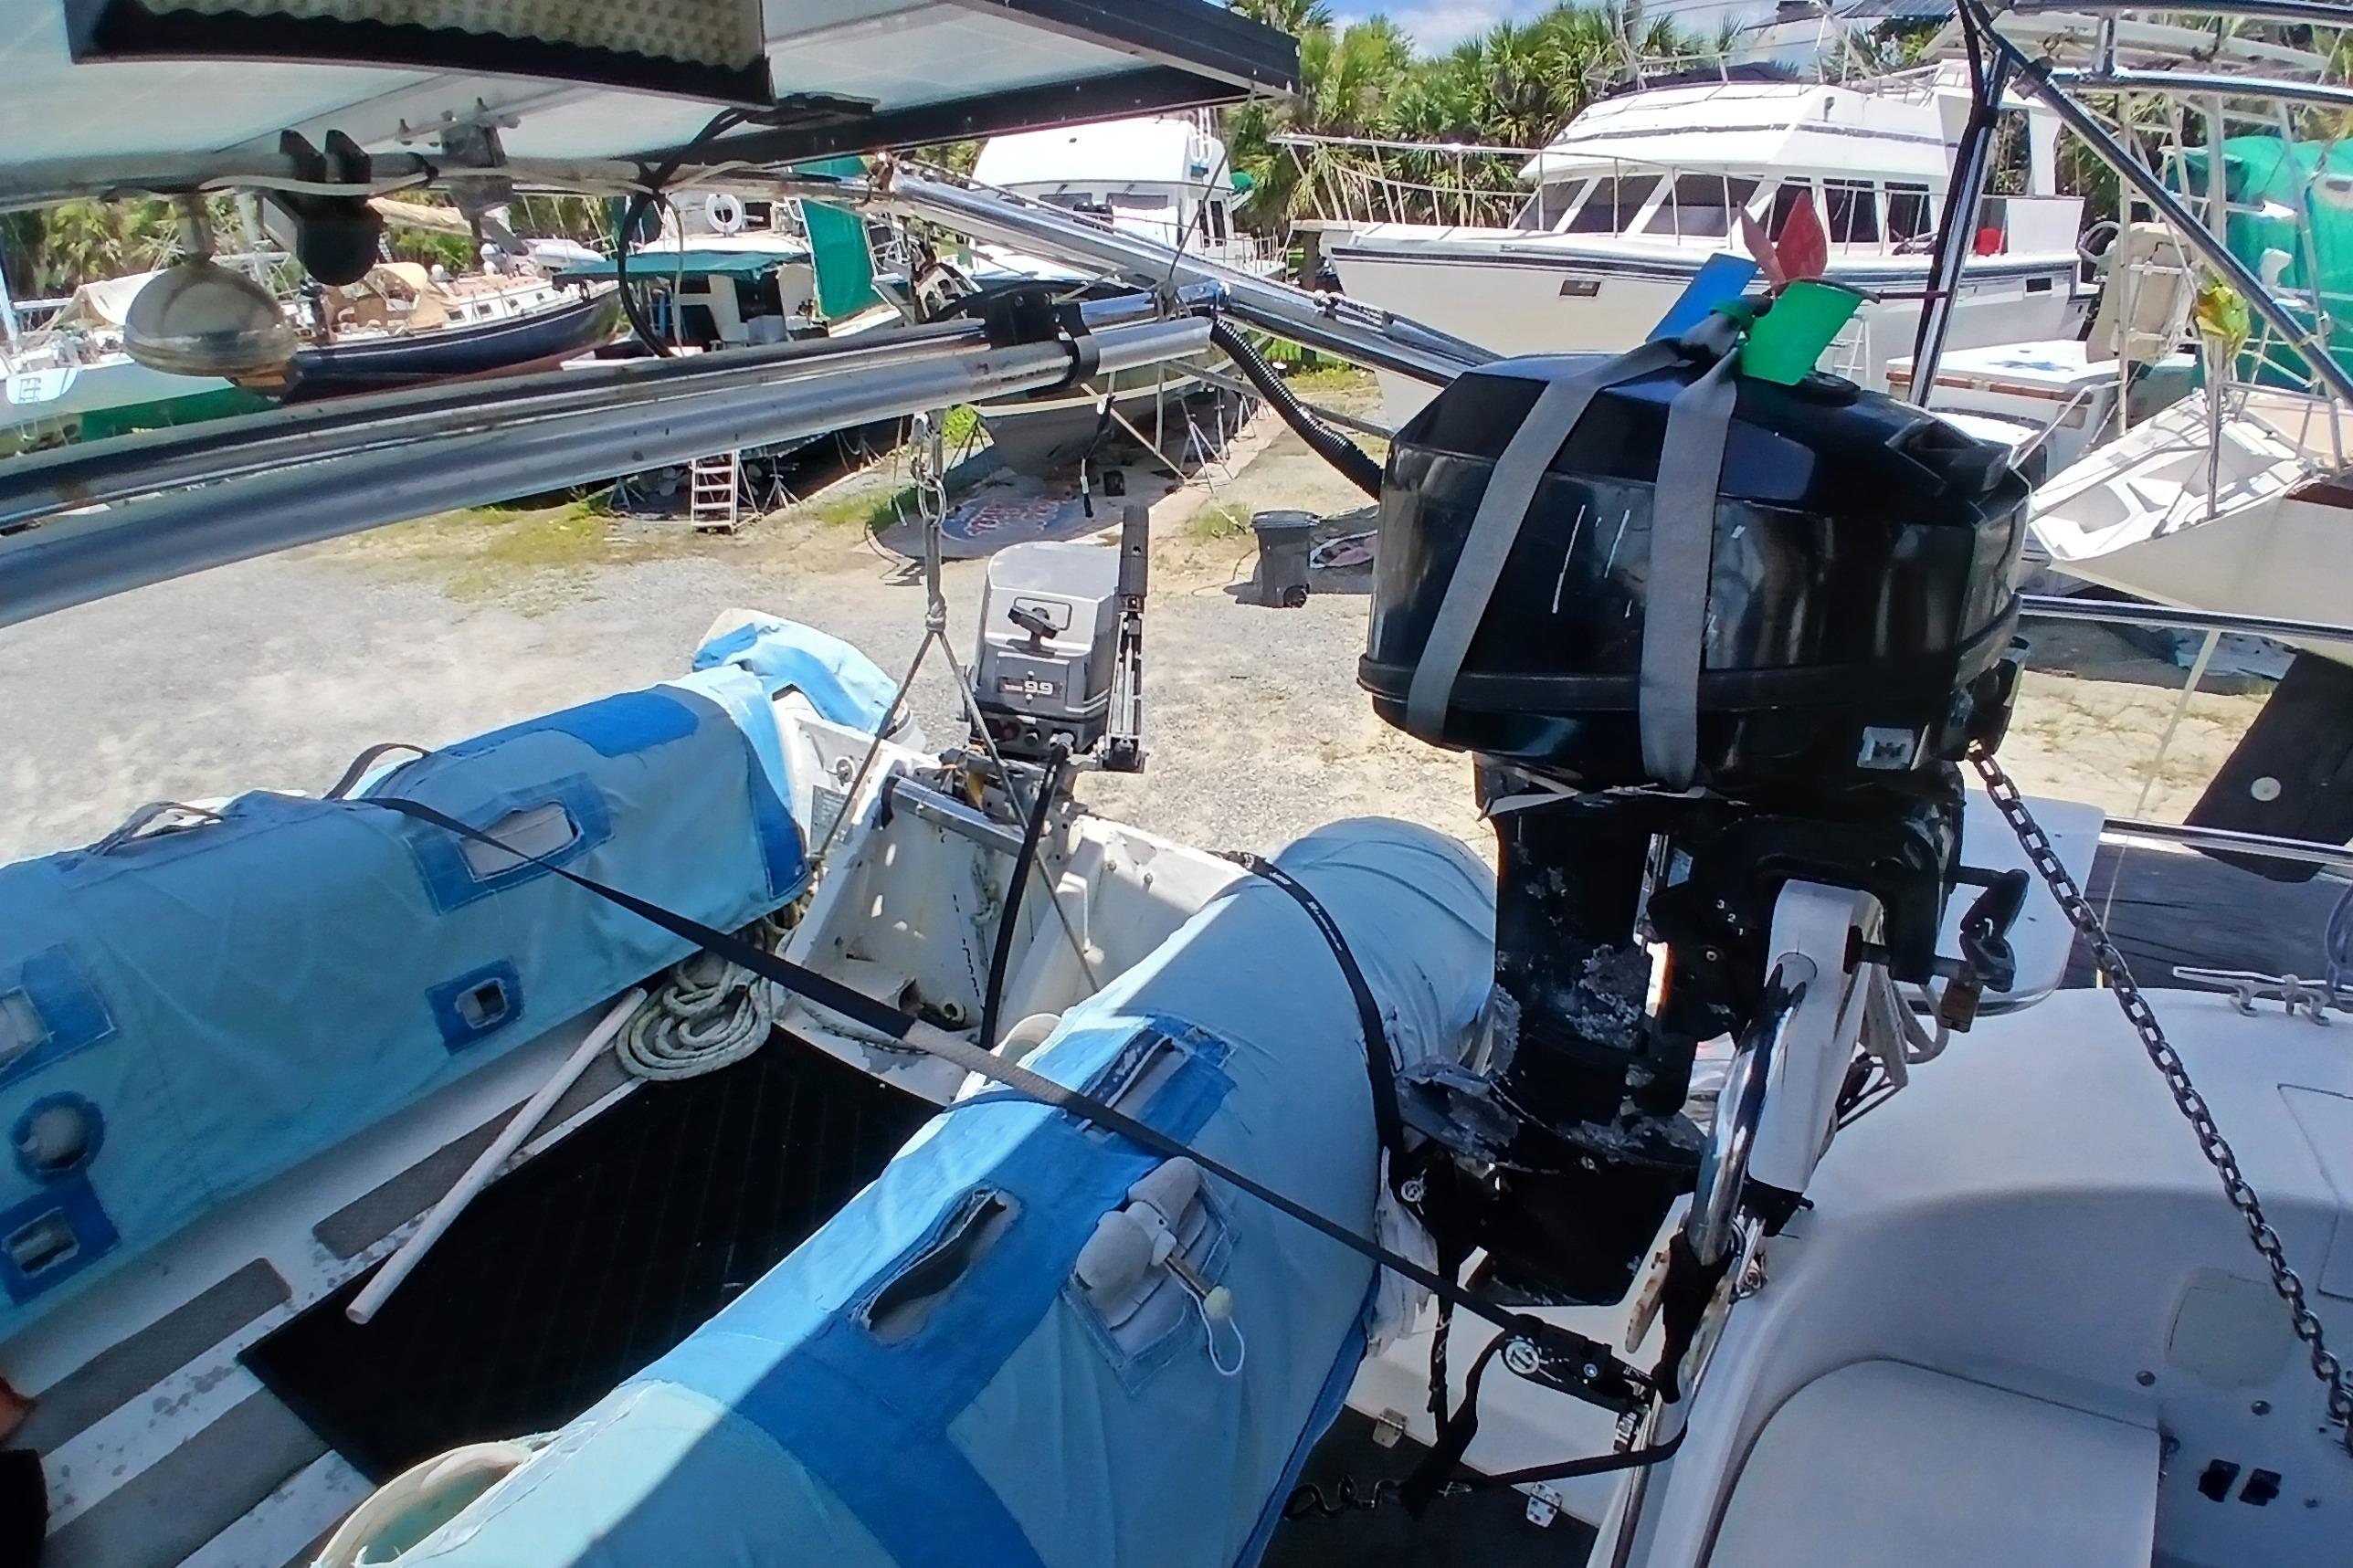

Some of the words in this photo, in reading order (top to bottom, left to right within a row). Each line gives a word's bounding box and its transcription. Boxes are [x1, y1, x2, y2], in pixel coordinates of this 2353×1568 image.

[1716, 899, 1725, 910] 3
[1727, 912, 1736, 923] 2
[1738, 927, 1744, 936] 1
